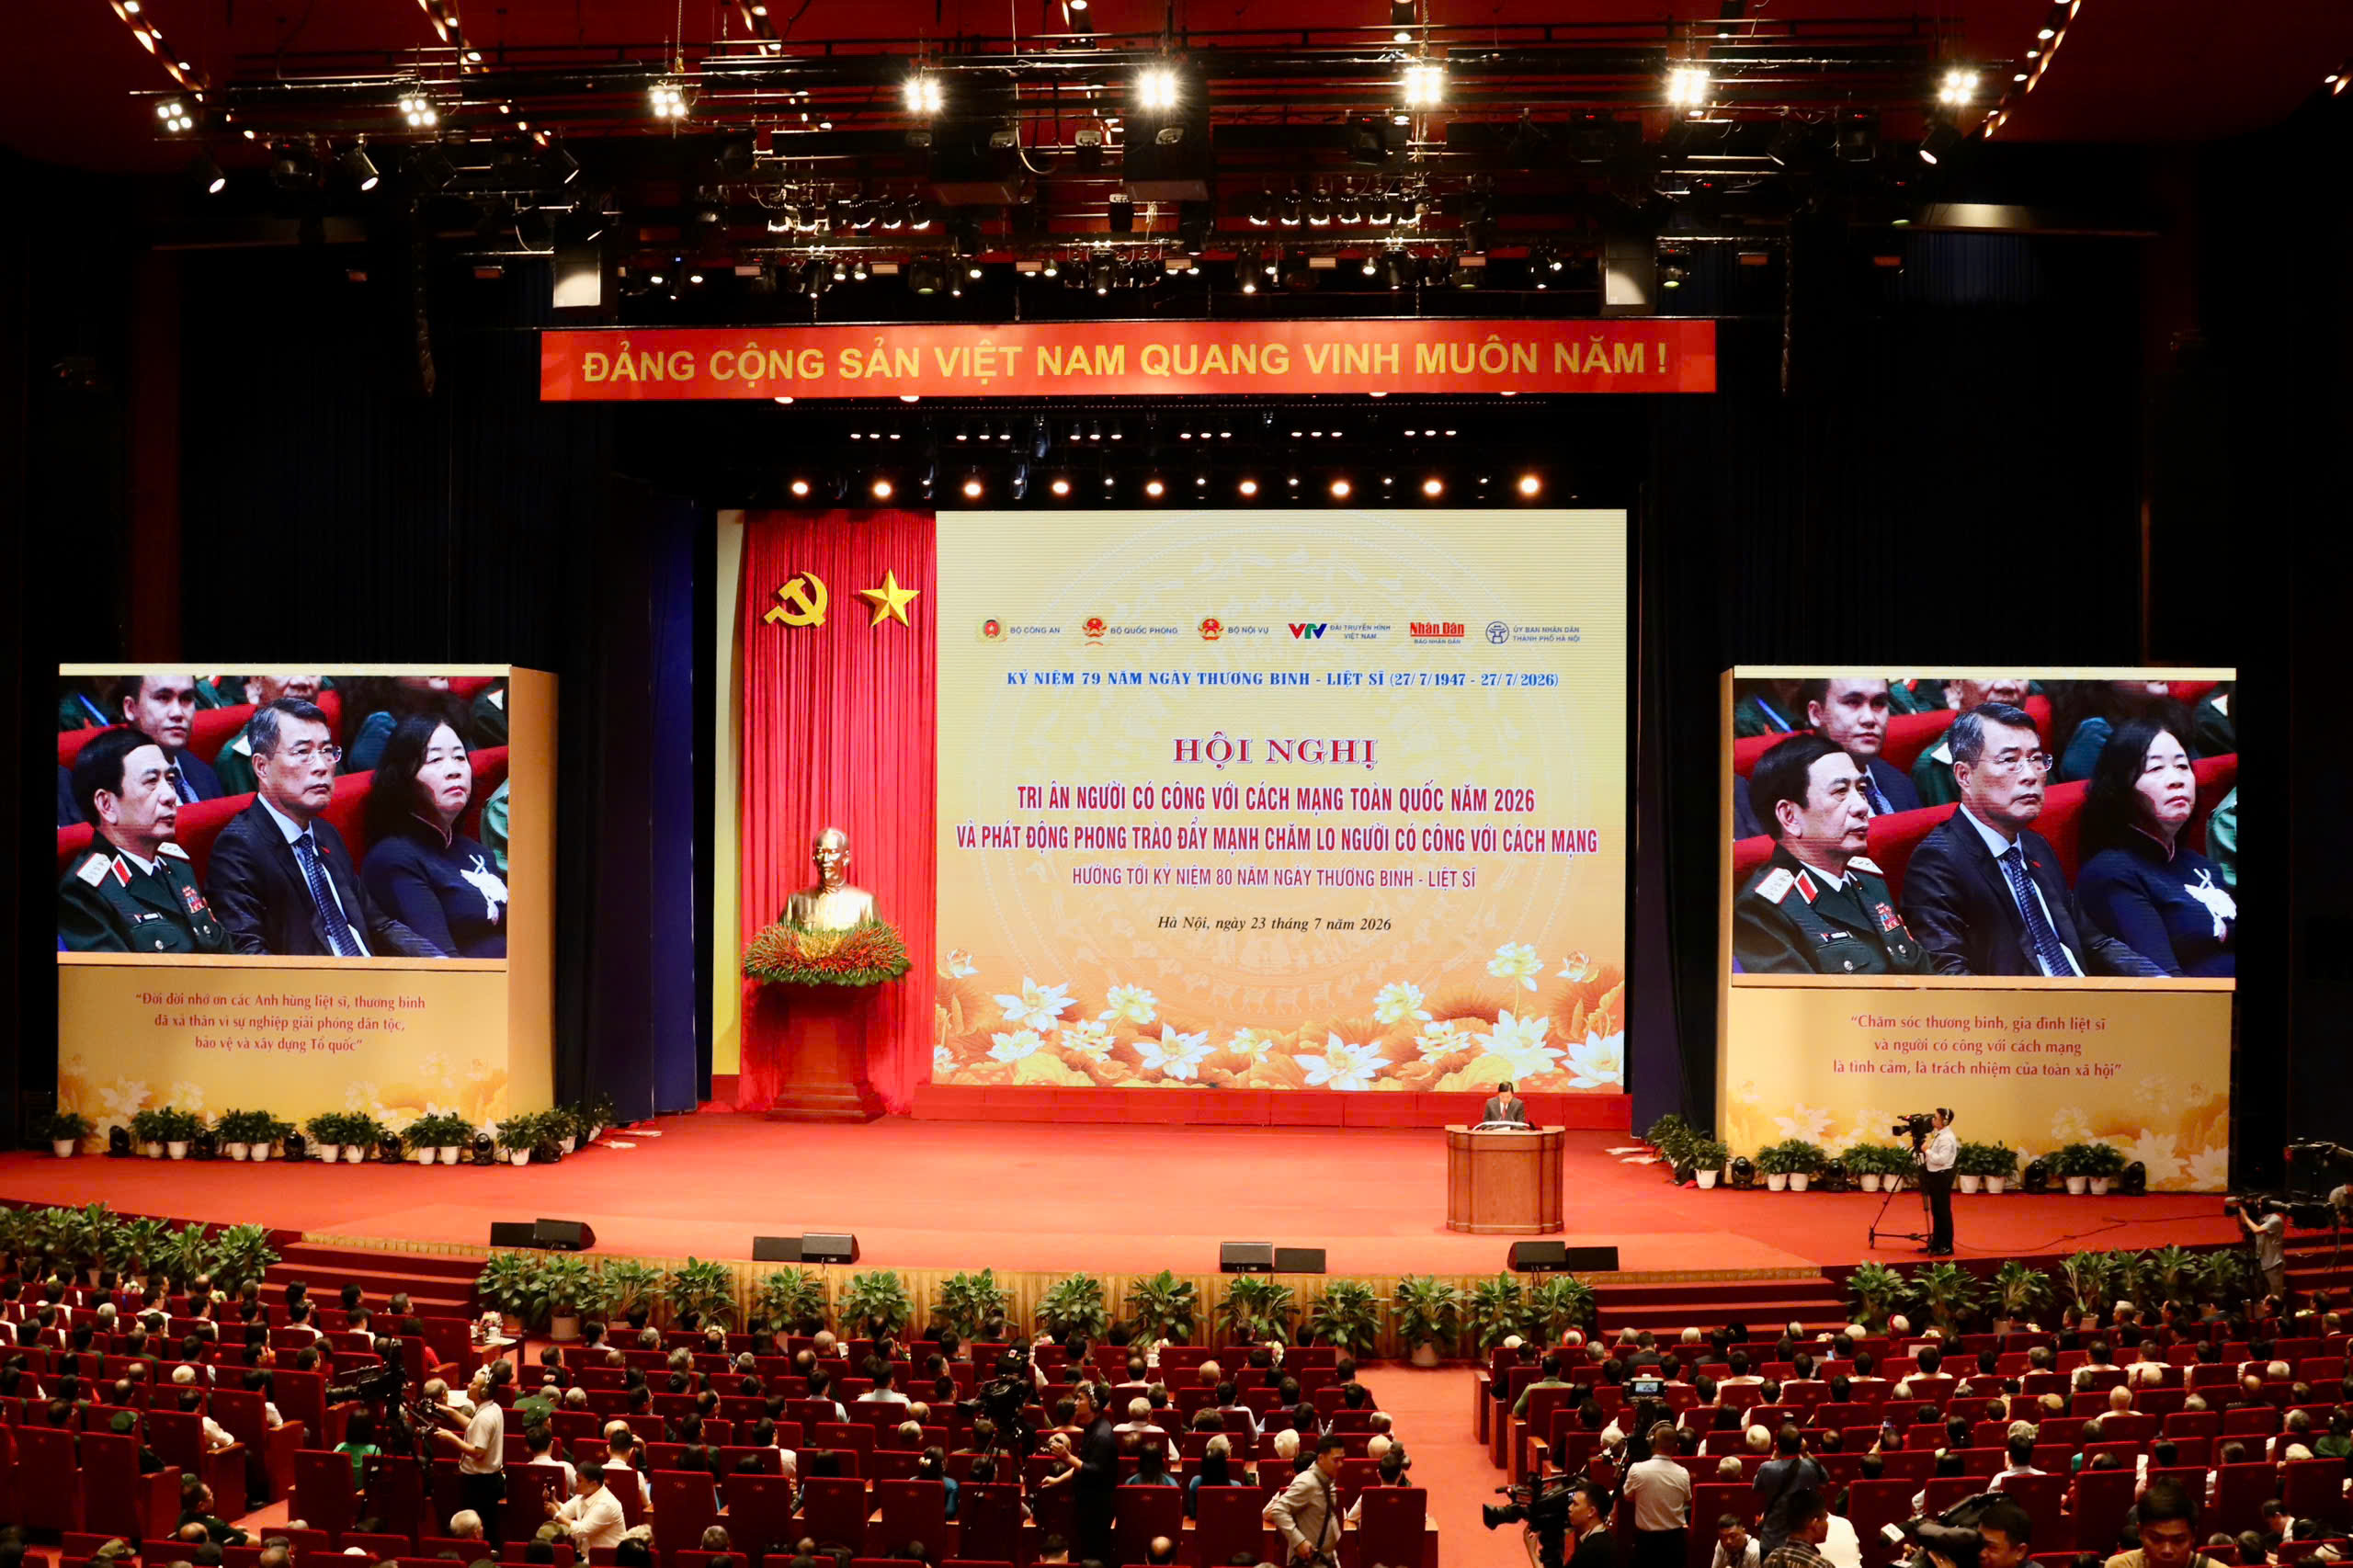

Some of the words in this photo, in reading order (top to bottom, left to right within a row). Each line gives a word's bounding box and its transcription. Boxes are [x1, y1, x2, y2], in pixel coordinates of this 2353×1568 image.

[582, 341, 696, 382] ĐẢNG
[709, 342, 825, 389] CỘNG
[838, 337, 920, 380] SẢN
[934, 338, 1023, 385] VIỆT
[1037, 345, 1126, 376] NAM
[1140, 343, 1290, 378] QUANG
[1303, 343, 1399, 374] VINH
[1415, 335, 1538, 374] MUÔN
[1553, 336, 1645, 374] NĂM
[1656, 343, 1666, 372] !
[1009, 626, 1023, 635] BỘ
[1025, 624, 1047, 634] CÔNG
[1048, 626, 1061, 634] AN
[1109, 626, 1122, 635] BỘ
[1123, 624, 1147, 634] QUỐC
[1149, 625, 1178, 634] PHÒNG
[1227, 625, 1241, 635] BỘ
[1242, 625, 1256, 635] NỘI
[1257, 626, 1269, 635] VỤ
[1288, 623, 1328, 639] VTV
[1344, 632, 1359, 641] VIỆT
[1409, 621, 1439, 635] Nhân
[1441, 621, 1465, 635] Dân
[1006, 669, 1029, 685] KỶ
[1034, 669, 1074, 687] NIỆM
[1081, 672, 1101, 685] 79
[1108, 670, 1142, 685] NĂM
[1149, 670, 1191, 685] NGÀY
[1197, 671, 1264, 686] THƯƠNG
[1269, 673, 1310, 686] BINH
[1326, 669, 1363, 688] LIỆT
[1368, 670, 1384, 686] SĨ
[1172, 731, 1252, 770] HỘI
[1265, 738, 1379, 770] NGHỊ
[1017, 786, 1042, 810] TRI
[1049, 780, 1070, 810] ÂN
[1076, 780, 1125, 810] NGƯỜI
[1132, 780, 1154, 810] CÓ
[1161, 781, 1205, 810] CÔNG
[1211, 781, 1239, 810] VỚI
[1245, 780, 1290, 811] CÁCH
[1296, 787, 1344, 815] MẠNG
[1350, 781, 1392, 812] TOÀN
[1399, 779, 1444, 813] QUỐC
[1451, 783, 1487, 812] NĂM
[1495, 789, 1535, 812] 2026
[956, 820, 976, 848] VÀ
[982, 820, 1021, 848] PHÁT
[1026, 821, 1068, 854] ĐỘNG
[1074, 826, 1127, 849] PHONG
[1131, 820, 1172, 849] TRÀO
[1176, 815, 1208, 849] ĐẨY
[1213, 826, 1259, 856] MẠNH
[1265, 824, 1311, 851] CHĂM
[1316, 827, 1335, 851] LO
[1341, 822, 1389, 851] NGƯỜI
[1395, 823, 1416, 851] CÓ
[1422, 824, 1465, 852] CÔNG
[1471, 824, 1497, 852] VỚI
[1502, 824, 1545, 853] CÁCH
[1552, 829, 1597, 858] MẠNG
[1073, 863, 1121, 885] HƯỚNG
[1126, 863, 1149, 885] TỚI
[1154, 863, 1172, 885] KỶ
[1176, 863, 1211, 889] NIỆM
[1216, 868, 1233, 885] 80
[1237, 864, 1268, 886] NĂM
[1274, 863, 1313, 887] NGÀY
[1317, 868, 1375, 887] THƯƠNG
[1380, 869, 1414, 887] BINH
[1427, 867, 1458, 891] LIỆT
[1462, 867, 1476, 888] SĨ
[1157, 916, 1177, 929] Hà
[1182, 916, 1211, 931] Nội,
[1215, 917, 1246, 931] ngày
[1251, 917, 1267, 929] 23
[1271, 917, 1309, 932] tháng
[1313, 918, 1323, 930] 7
[1325, 917, 1355, 930] năm
[1359, 918, 1392, 931] 2026
[165, 992, 185, 1005] đời
[188, 994, 210, 1006] nhớ
[212, 996, 227, 1006] ơn
[231, 994, 251, 1006] các
[255, 994, 279, 1006] Anh
[282, 994, 312, 1009] hùng
[314, 994, 334, 1009] liệt
[354, 995, 395, 1010] thương
[398, 995, 426, 1009] binh
[154, 1015, 168, 1027] đã
[173, 1014, 186, 1027] xả
[188, 1015, 215, 1027] thân
[218, 1015, 229, 1028] vì
[233, 1017, 246, 1029] sự
[248, 1016, 289, 1030] nghiệp
[292, 1015, 313, 1030] giải
[317, 1017, 354, 1031] phóng
[357, 1017, 380, 1030] dân
[382, 1017, 405, 1032] tộc,
[1900, 1016, 1921, 1028] sóc
[1926, 1017, 1971, 1032] thương
[1974, 1017, 2008, 1030] binh,
[2012, 1017, 2032, 1032] gia
[2036, 1017, 2066, 1030] đình
[2070, 1017, 2091, 1033] liệt
[2095, 1017, 2107, 1030] sĩ
[195, 1035, 216, 1049] bảo
[220, 1038, 233, 1051] vệ
[236, 1038, 251, 1050] và
[254, 1038, 273, 1052] xây
[277, 1038, 306, 1052] dựng
[310, 1035, 325, 1051] Tổ
[1873, 1039, 1889, 1051] và
[1893, 1039, 1928, 1054] người
[1932, 1040, 1948, 1051] có
[1951, 1040, 1984, 1055] công
[1986, 1040, 2006, 1051] với
[2010, 1040, 2041, 1052] cách
[2045, 1043, 2082, 1057] mạng
[1834, 1060, 1845, 1074] là
[1848, 1061, 1875, 1074] tình
[1879, 1061, 1911, 1075] cảm,
[1915, 1061, 1927, 1074] là
[1931, 1062, 1966, 1074] trách
[1970, 1062, 2011, 1078] nhiệm
[2015, 1061, 2038, 1075] của
[2041, 1062, 2071, 1076] toàn
[2075, 1062, 2090, 1076] xã
